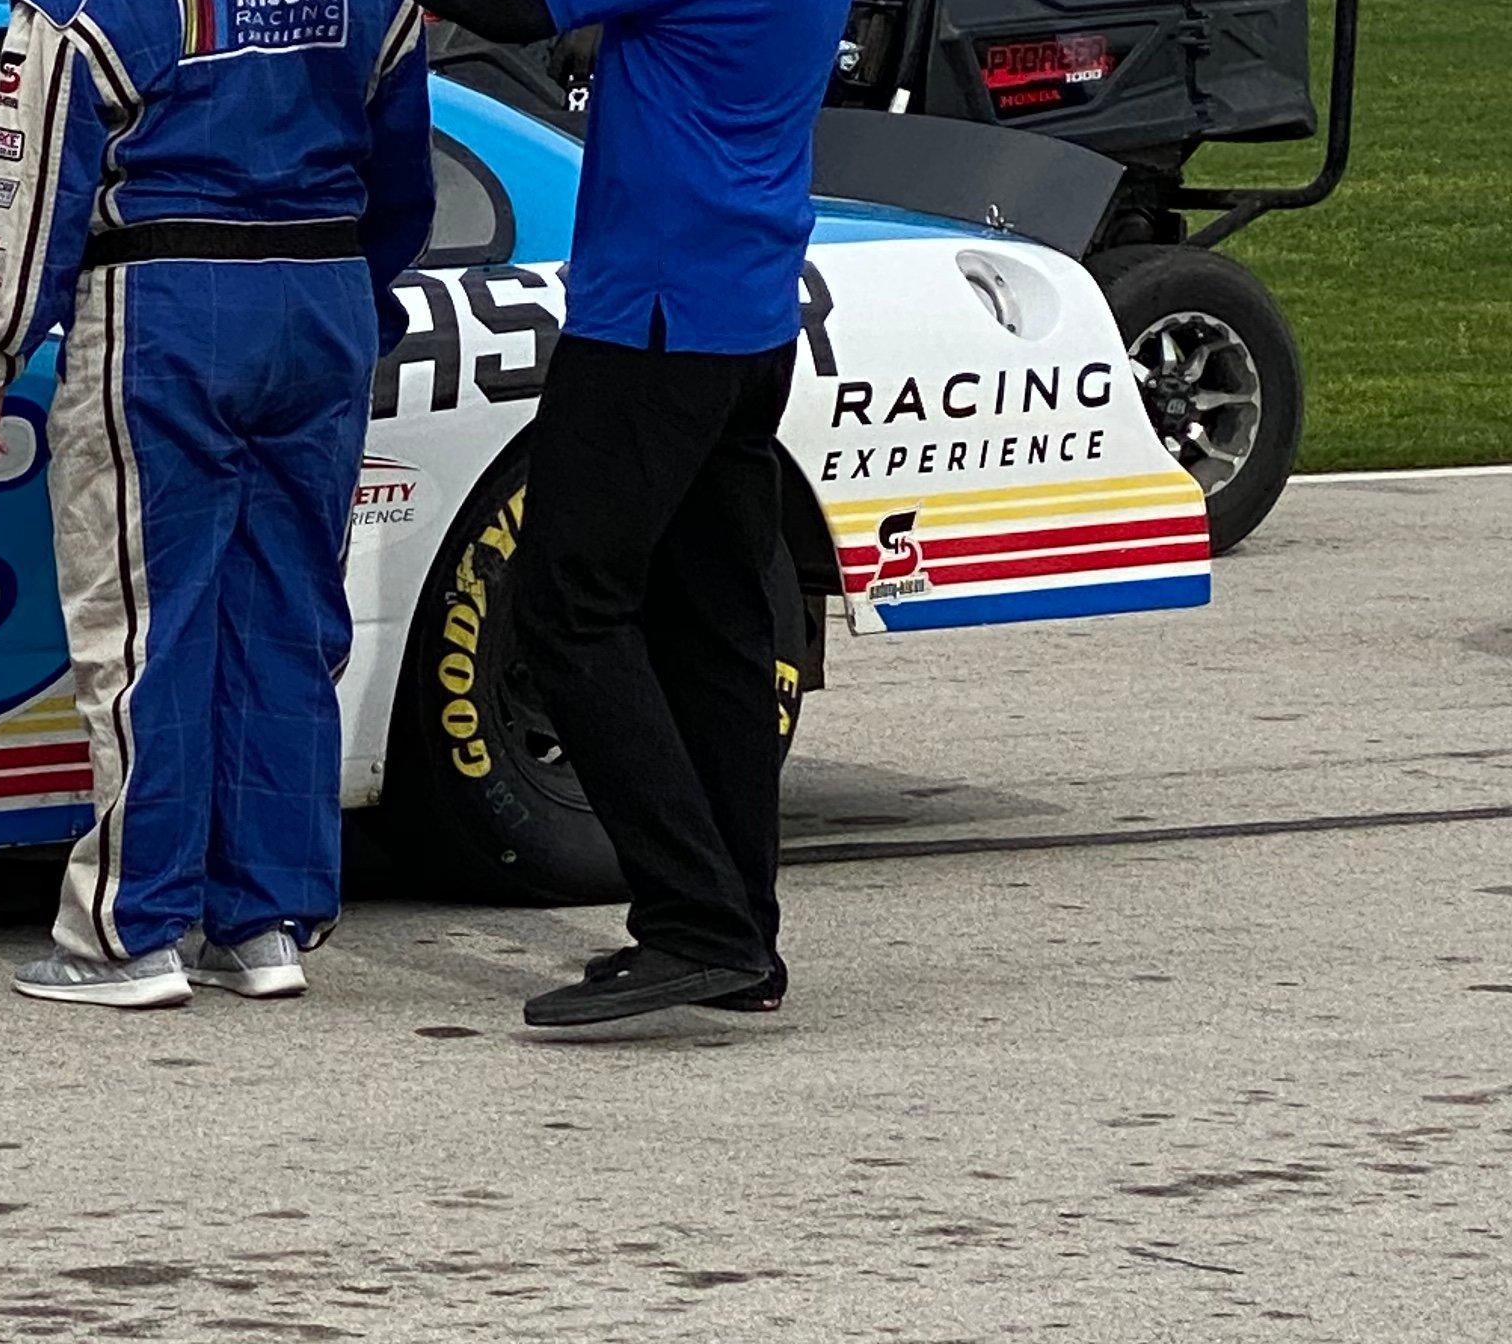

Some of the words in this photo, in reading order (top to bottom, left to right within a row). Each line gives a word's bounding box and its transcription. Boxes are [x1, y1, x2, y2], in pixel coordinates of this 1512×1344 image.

[236, 6, 339, 26] RACING
[1065, 69, 1102, 83] 1000
[831, 362, 1112, 430] RACING
[822, 431, 1107, 480] EXPERIENCE
[354, 482, 417, 506] ETTY
[351, 508, 415, 526] RIENCE
